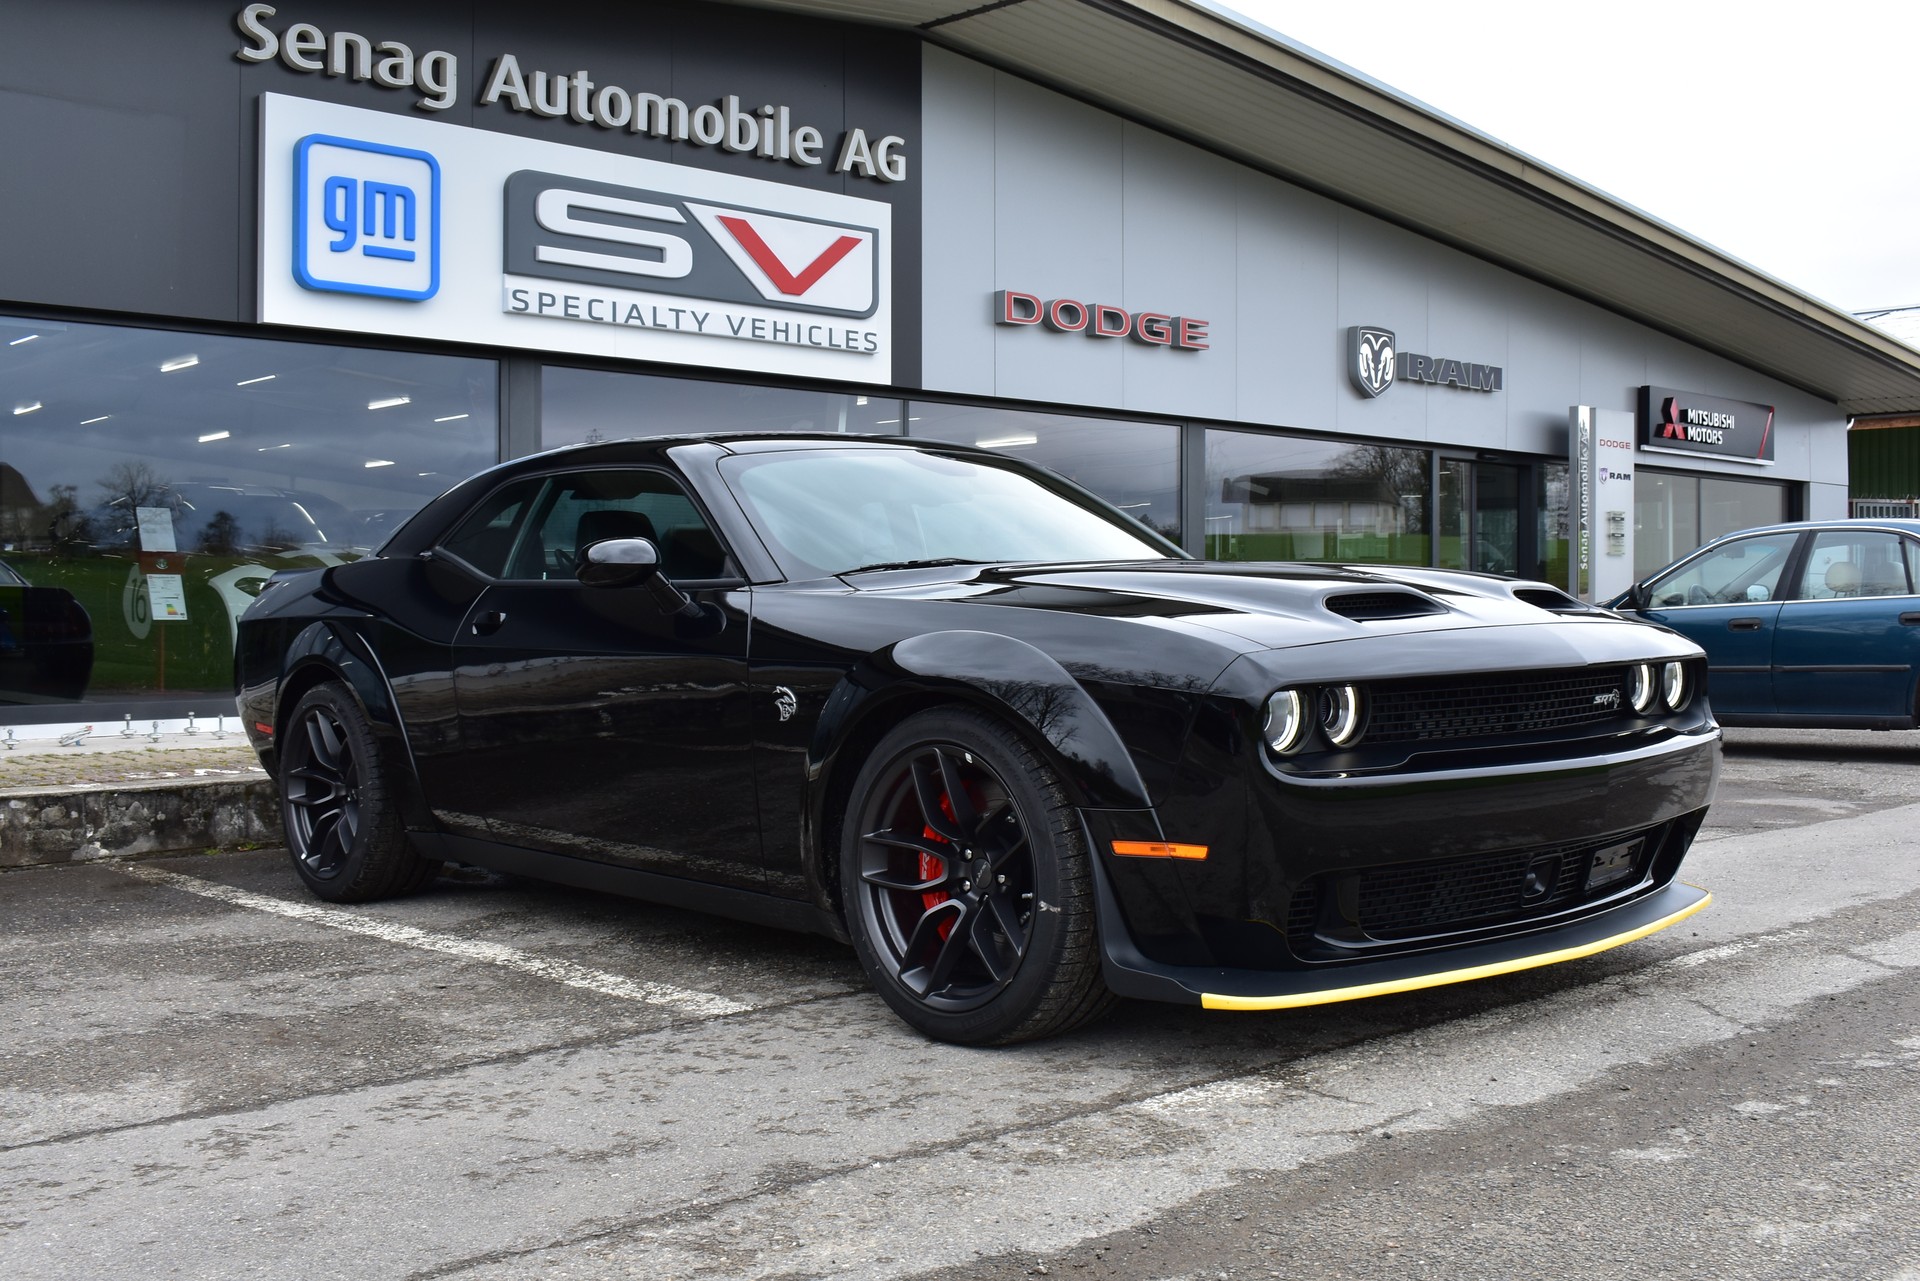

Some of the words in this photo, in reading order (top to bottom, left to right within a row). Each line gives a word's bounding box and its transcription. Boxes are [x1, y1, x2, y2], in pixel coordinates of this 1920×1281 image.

[236, 2, 458, 112] Senag
[479, 53, 824, 167] Automobile
[835, 127, 907, 183] AG
[324, 175, 416, 260] gm
[535, 188, 864, 296] SV
[511, 288, 709, 333] SPECIALTY
[726, 313, 878, 353] VEHICLES
[995, 289, 1210, 352] DODGE
[1397, 351, 1503, 393] RAM
[1687, 408, 1735, 429] MITSUBISHI
[1687, 426, 1723, 445] MOTORS
[1599, 438, 1631, 450] DODGE
[1580, 446, 1590, 525] Automobile
[1609, 472, 1631, 481] RAM
[1580, 529, 1590, 570] Senag
[1593, 694, 1615, 706] SRT
